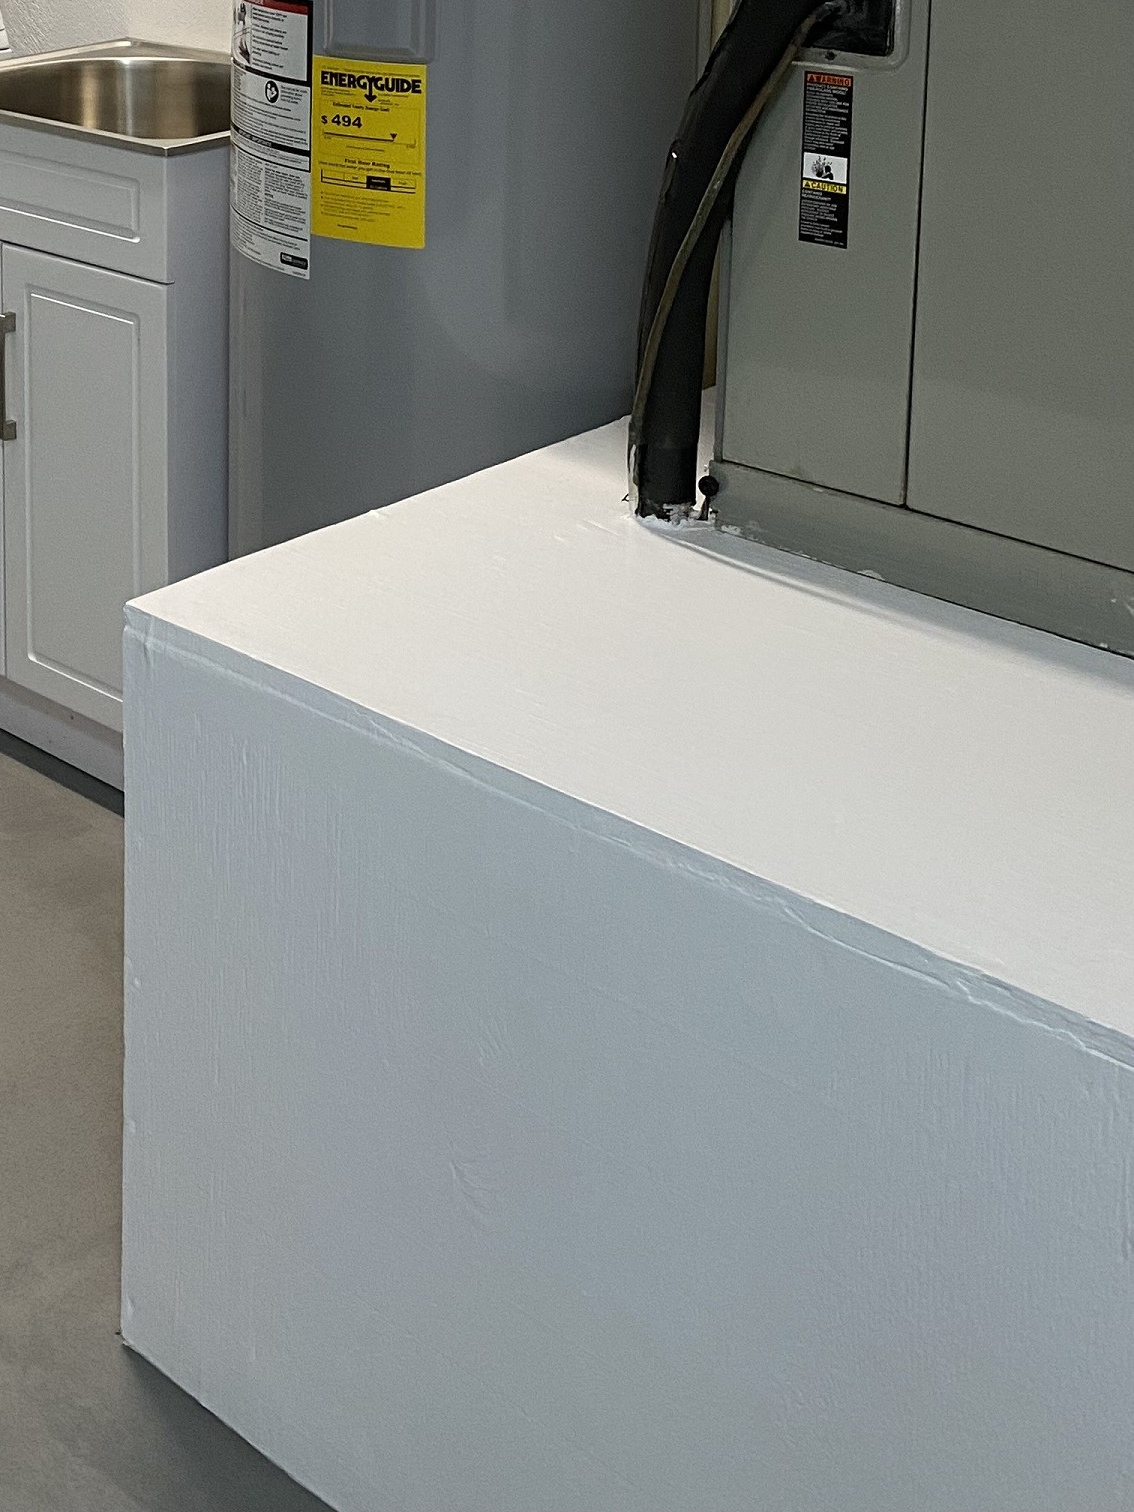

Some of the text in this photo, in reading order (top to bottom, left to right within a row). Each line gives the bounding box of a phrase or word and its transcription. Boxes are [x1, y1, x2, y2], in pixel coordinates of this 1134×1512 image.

[321, 70, 422, 95] ENERGYGUIDE
[331, 114, 363, 129] 494
[811, 182, 844, 193] CAUTION
